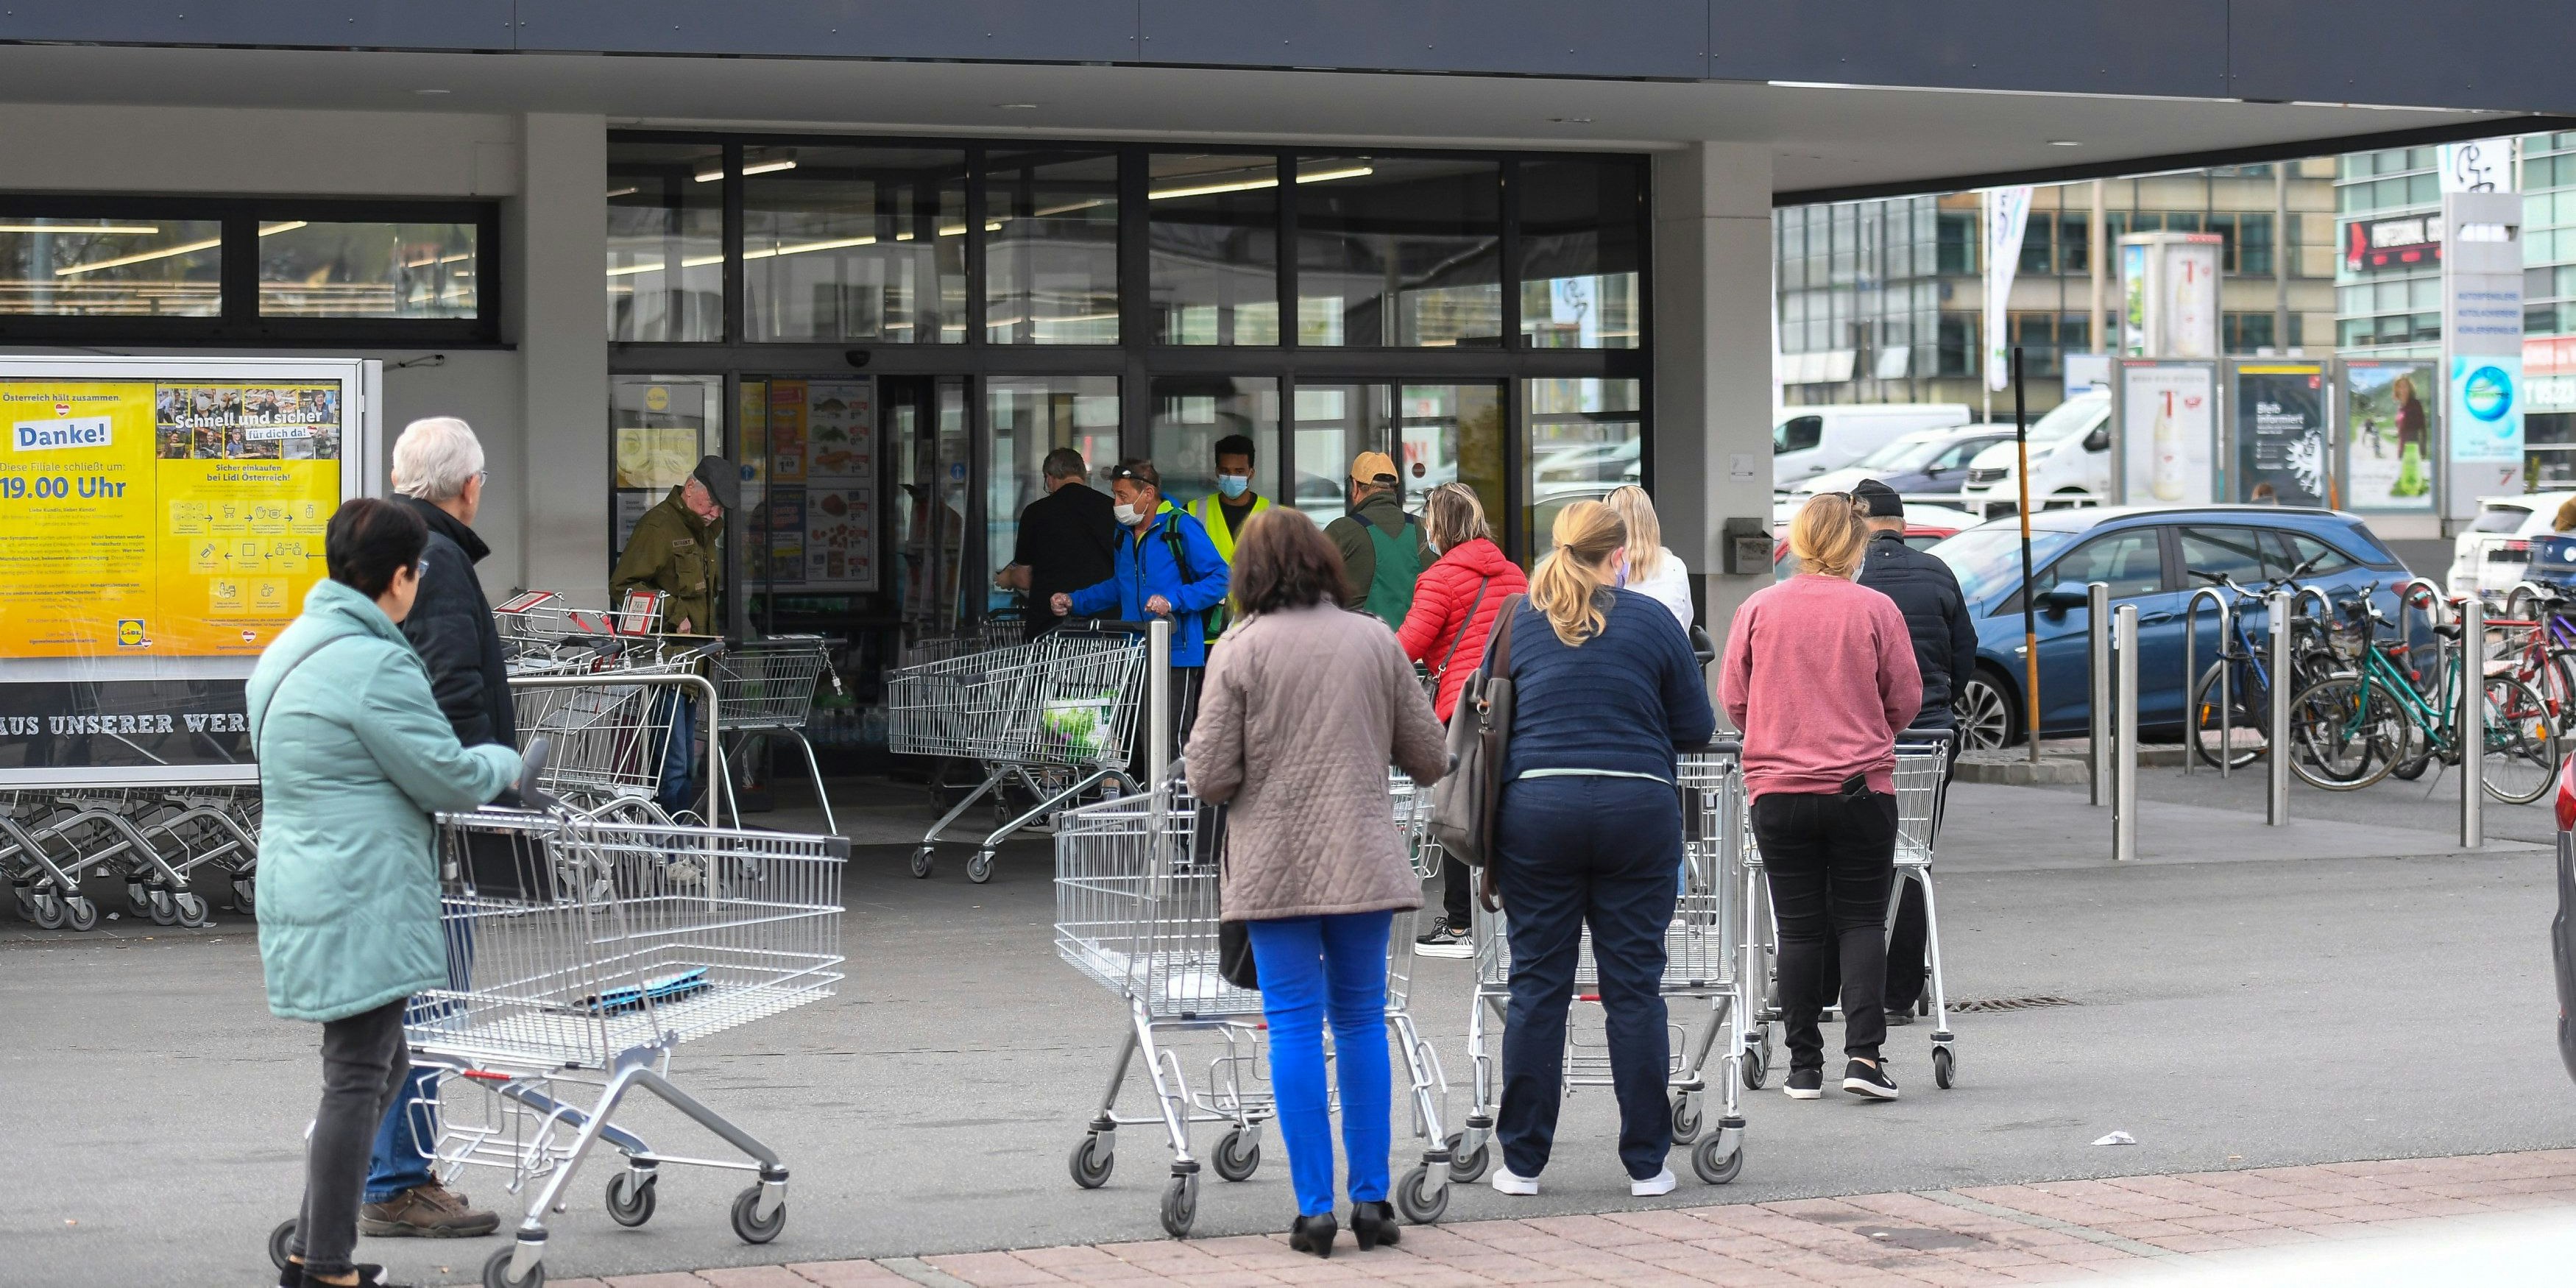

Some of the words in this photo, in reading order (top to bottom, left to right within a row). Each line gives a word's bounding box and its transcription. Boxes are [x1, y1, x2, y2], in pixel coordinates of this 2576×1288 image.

[3, 393, 49, 402] Österreich
[53, 393, 69, 402] hält
[2256, 401, 2282, 414] Bleib
[174, 411, 235, 429] Schnell
[238, 410, 270, 425] und
[274, 408, 322, 424] sicher
[2256, 414, 2305, 425] informiert
[18, 423, 105, 447] Danke!
[249, 430, 263, 440] für
[266, 428, 289, 439] dich
[291, 428, 306, 437] da!
[0, 462, 27, 472] Diese
[31, 462, 60, 472] Filiale
[64, 462, 104, 472] schließt
[107, 464, 126, 472] um:
[243, 464, 282, 473] einkaufen
[207, 473, 220, 481] bei
[223, 473, 239, 481] Lidl
[242, 472, 290, 481] Österreich!
[0, 476, 69, 499] 19.00
[78, 475, 127, 499] Uhr
[49, 713, 174, 735] UNSERER
[183, 712, 252, 733] WER
